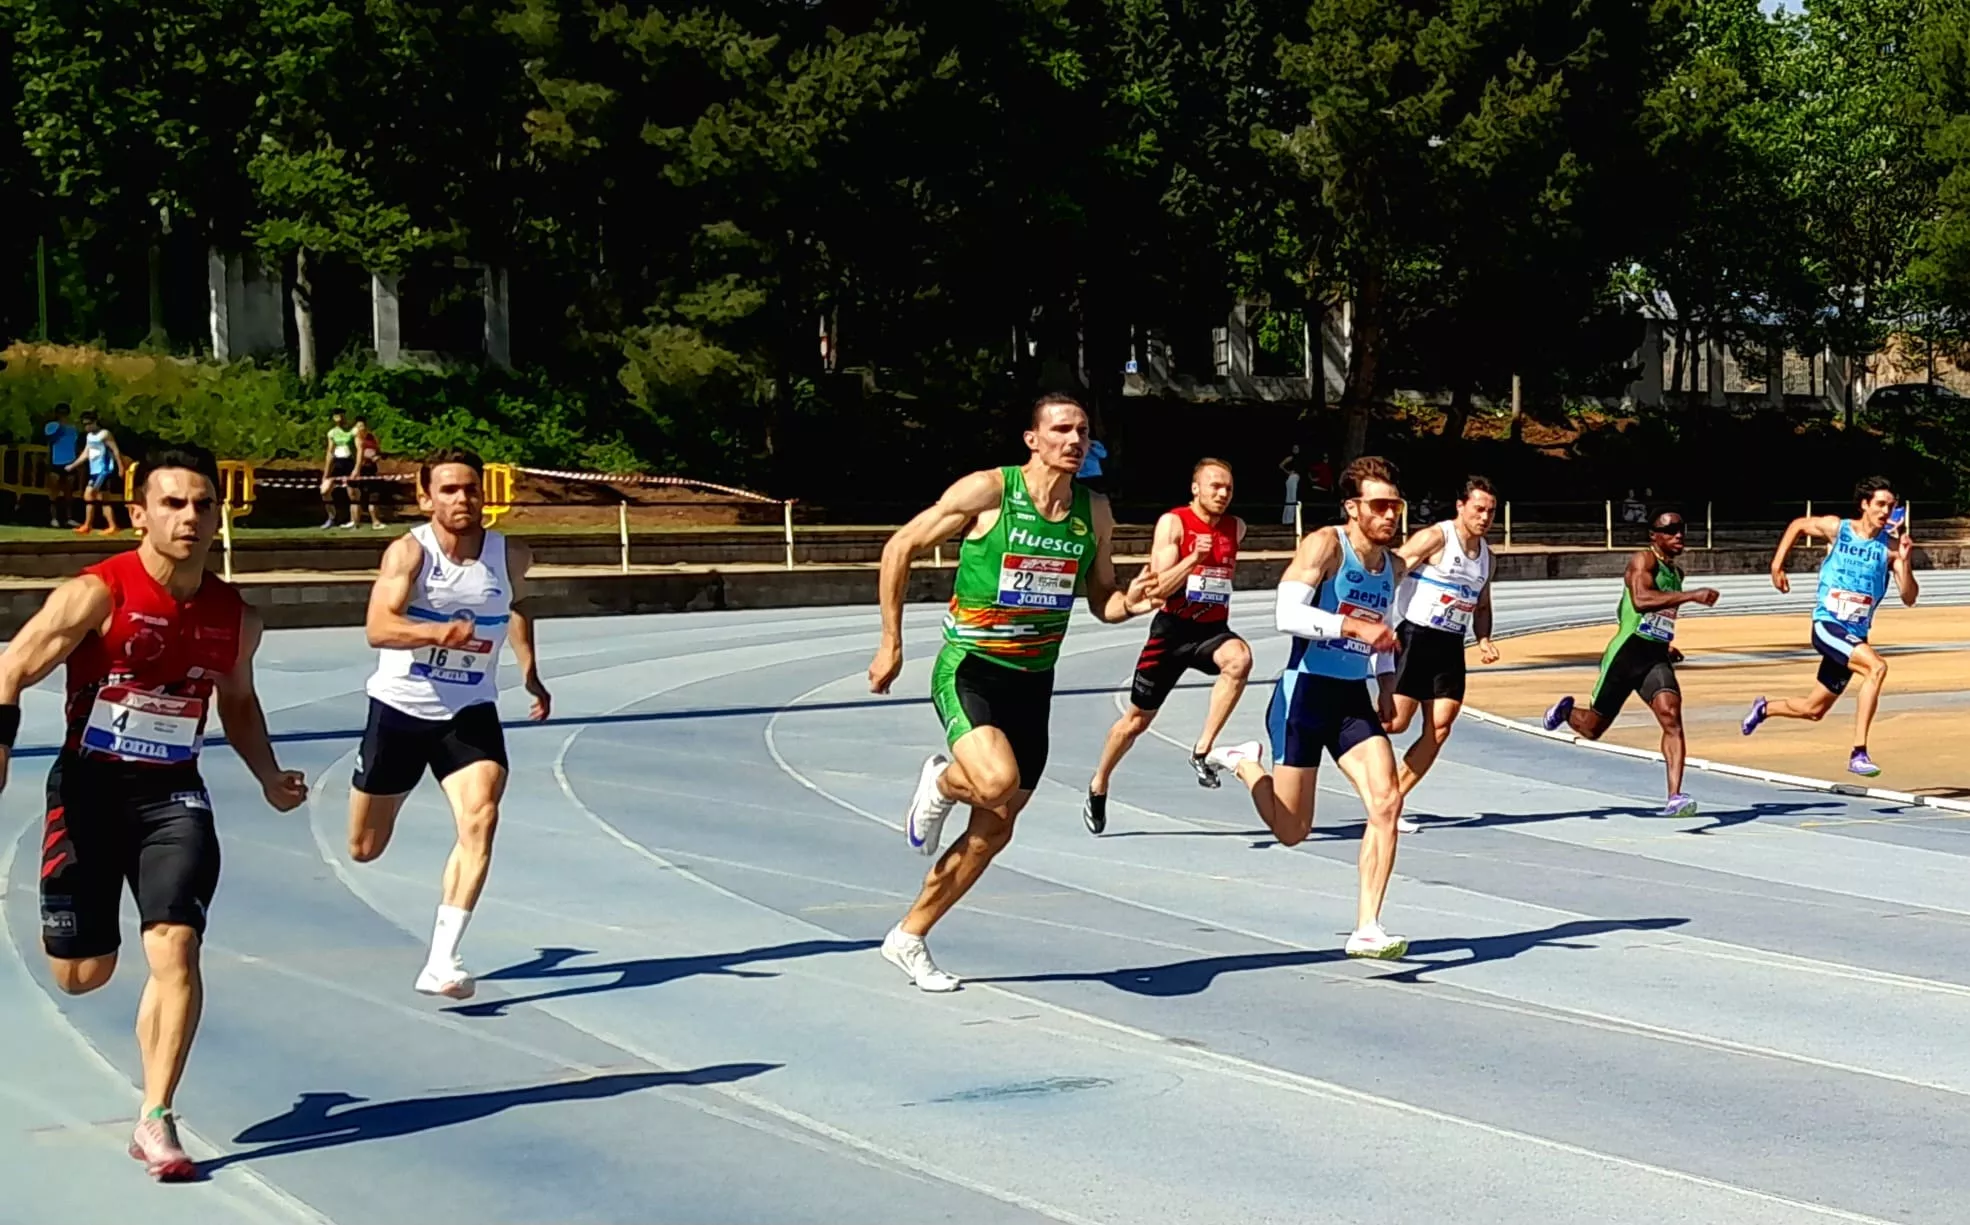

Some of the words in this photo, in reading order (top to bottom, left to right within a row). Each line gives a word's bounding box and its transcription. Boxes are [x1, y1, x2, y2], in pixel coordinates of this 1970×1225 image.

[1008, 527, 1085, 556] Huesca
[1012, 571, 1034, 591] 22
[1199, 576, 1207, 590] 3
[1347, 588, 1389, 608] nerja
[428, 647, 449, 667] 16
[112, 709, 130, 733] 4
[109, 735, 168, 758] Joma
